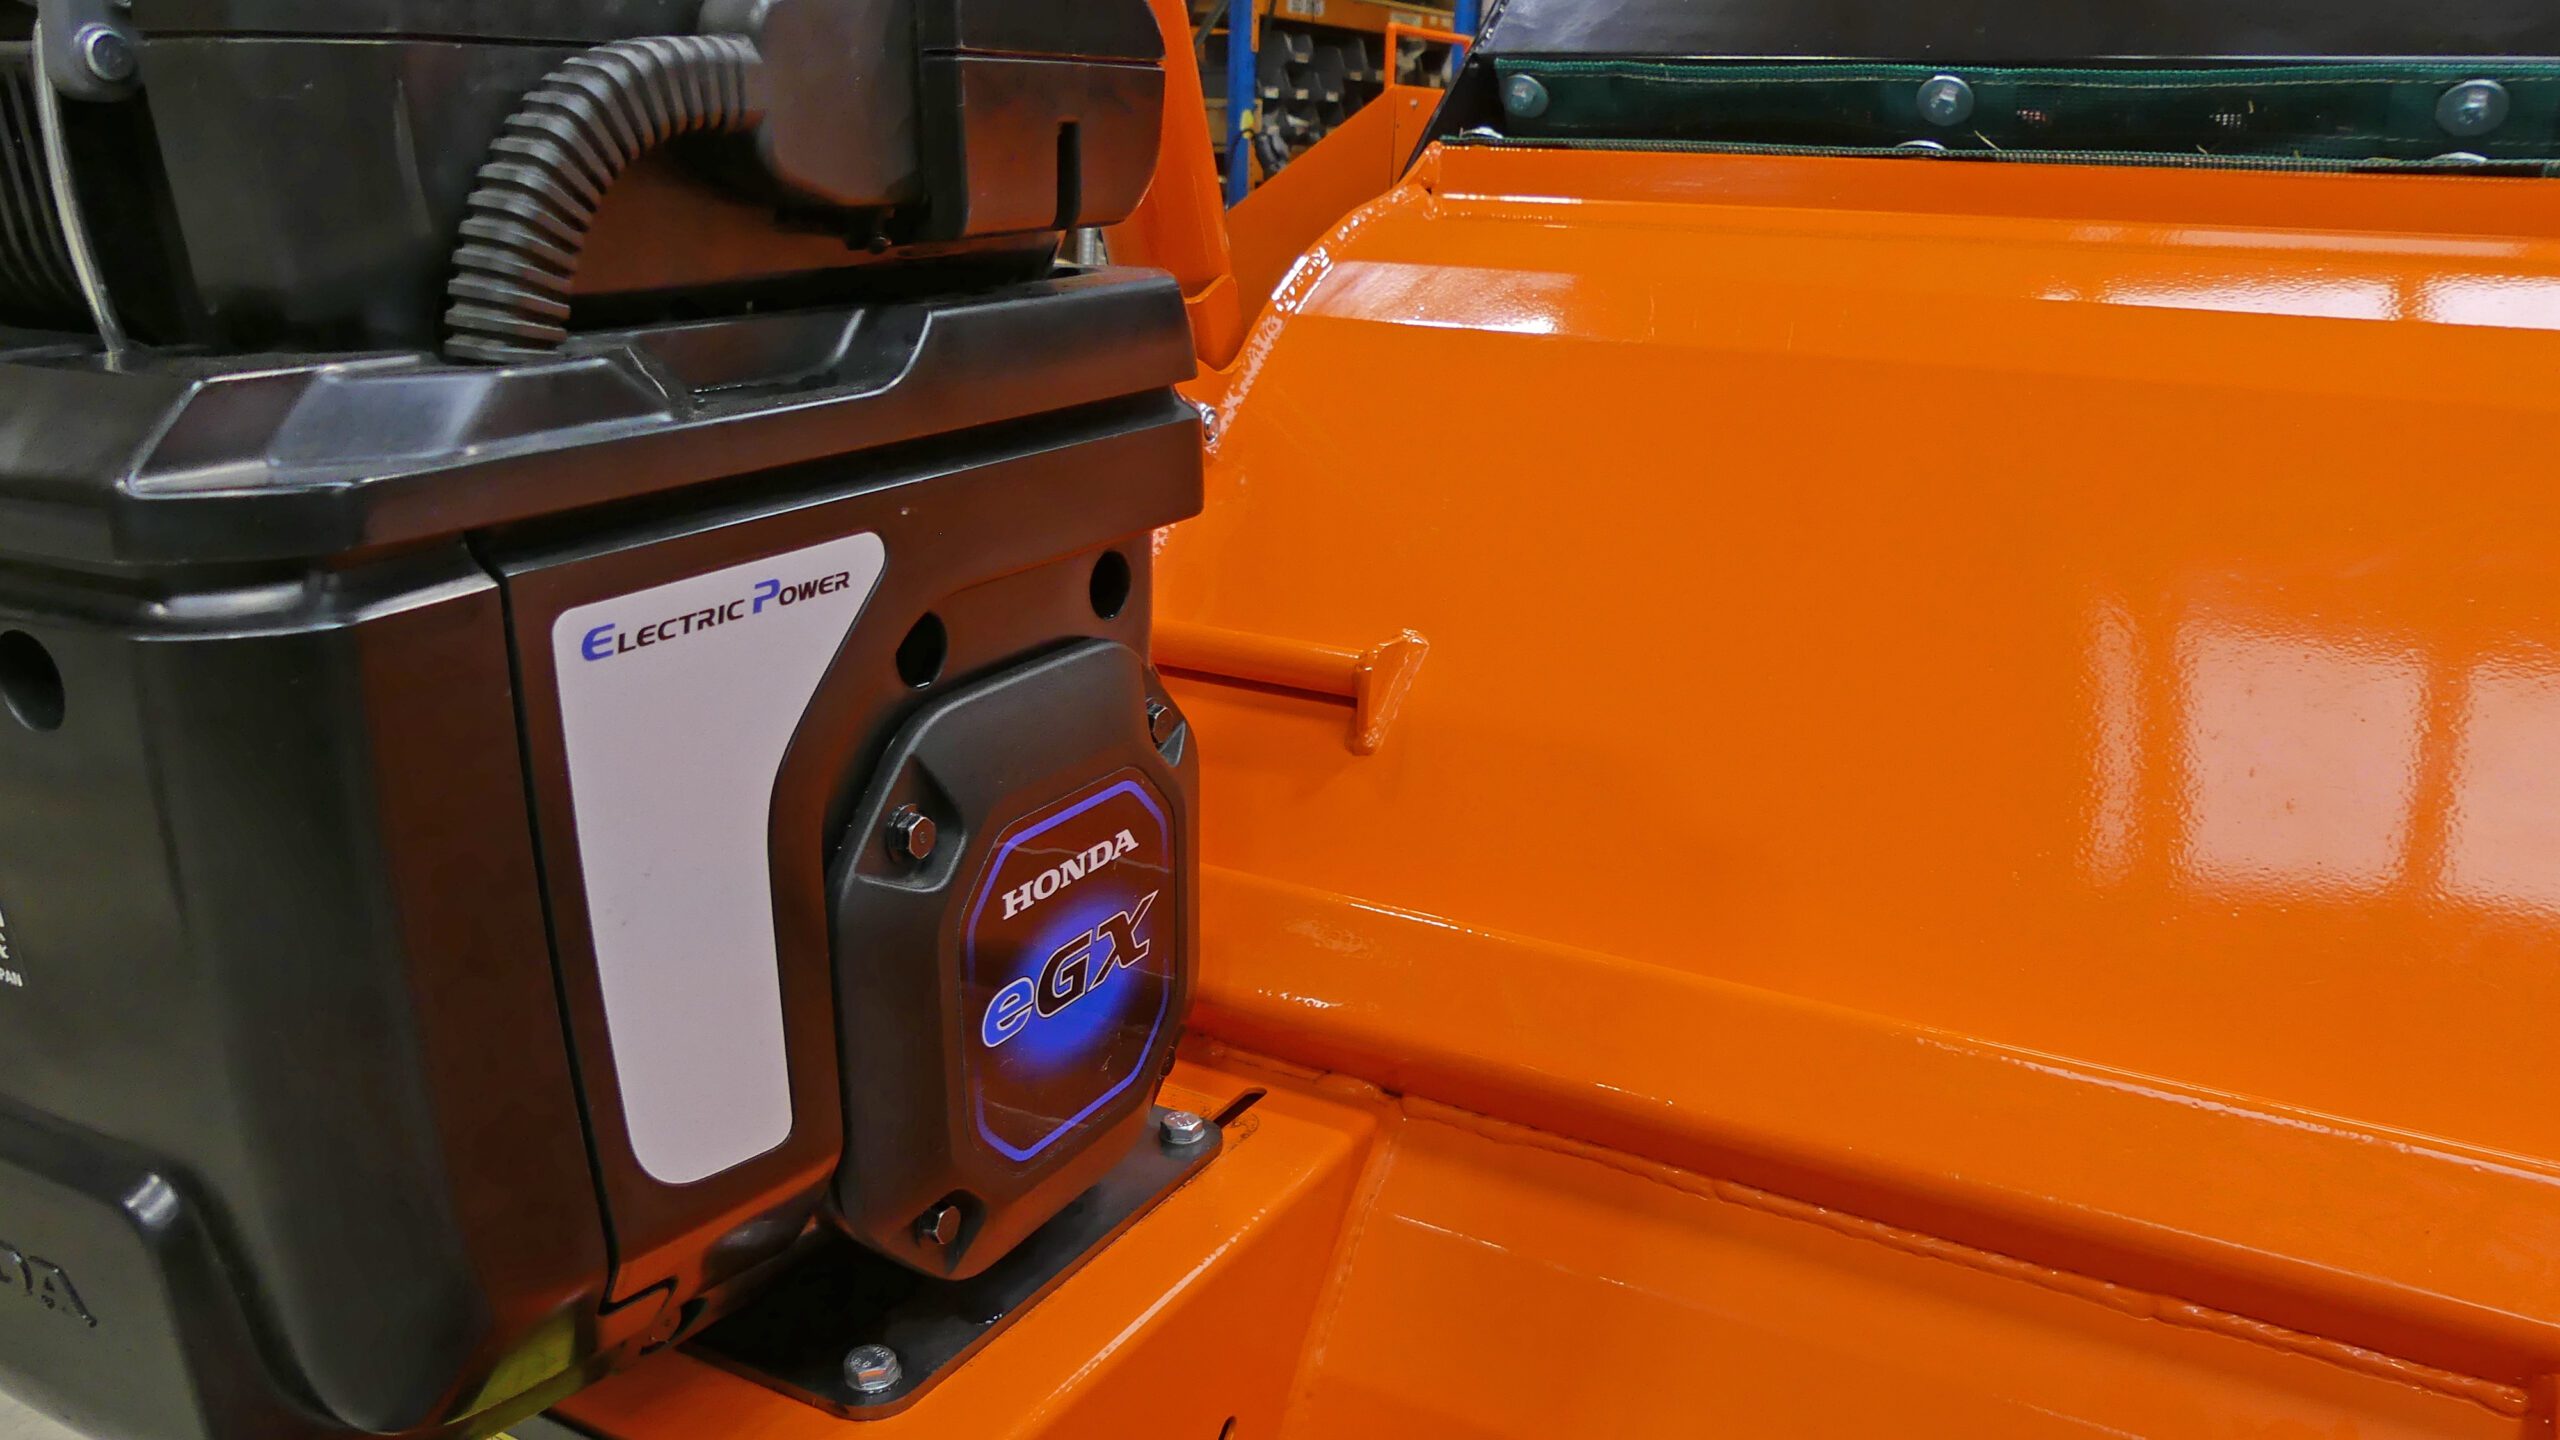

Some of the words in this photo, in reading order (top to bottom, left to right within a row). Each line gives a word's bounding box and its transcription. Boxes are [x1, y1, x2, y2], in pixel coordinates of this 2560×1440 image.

[581, 600, 745, 662] ELECTRIC
[752, 571, 850, 614] POWER
[1002, 828, 1140, 921] HONDA
[982, 889, 1160, 1048] eGX
